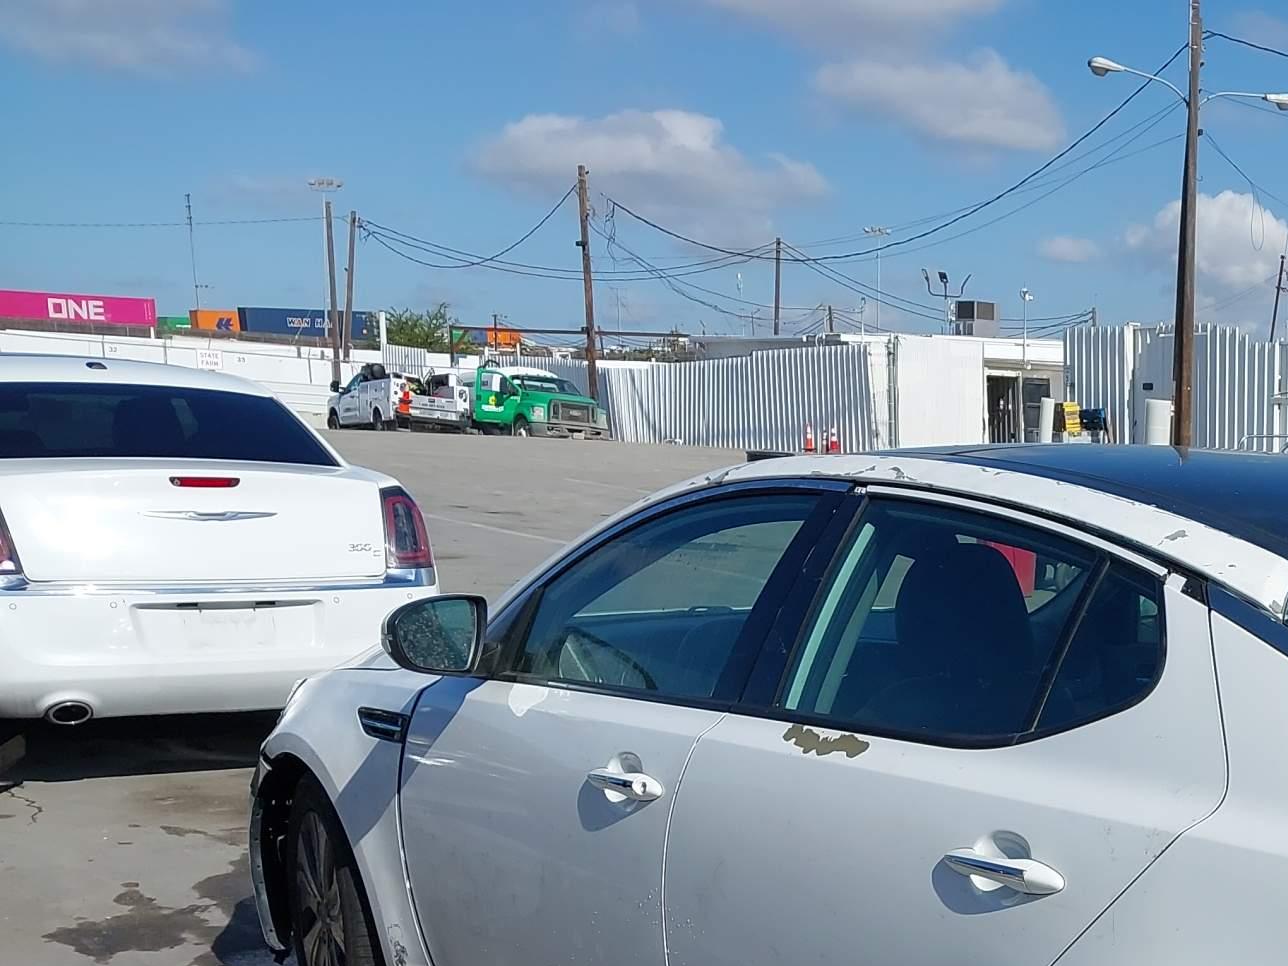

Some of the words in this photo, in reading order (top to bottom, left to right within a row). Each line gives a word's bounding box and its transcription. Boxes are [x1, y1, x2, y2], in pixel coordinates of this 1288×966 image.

[47, 297, 106, 321] ONE
[286, 316, 311, 328] WAN
[200, 352, 219, 360] STATE
